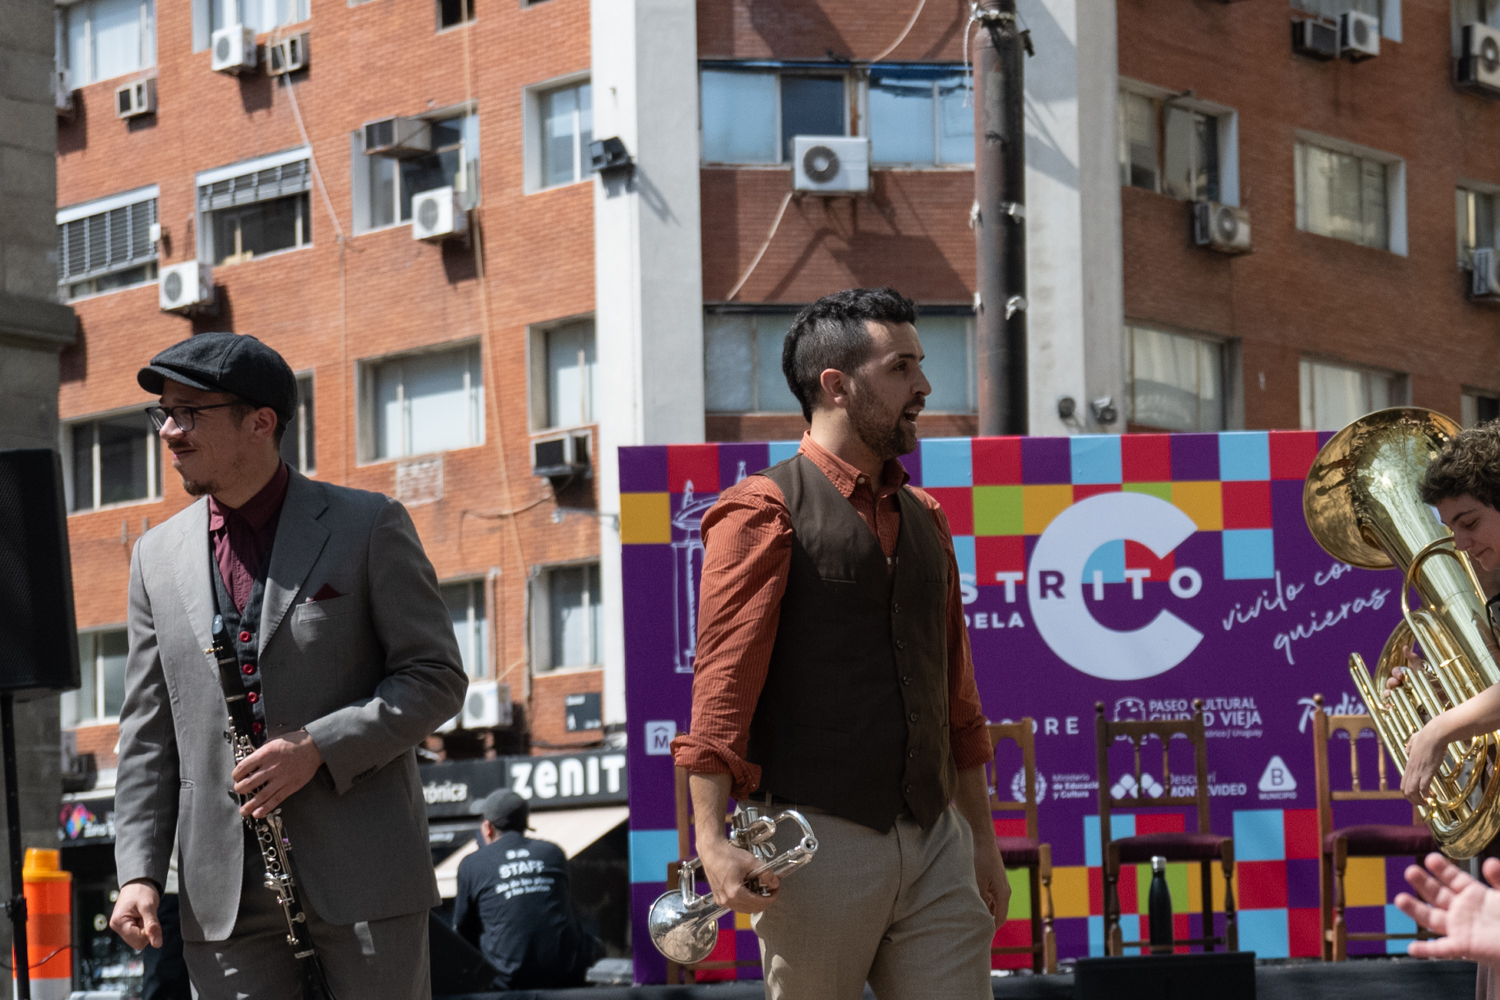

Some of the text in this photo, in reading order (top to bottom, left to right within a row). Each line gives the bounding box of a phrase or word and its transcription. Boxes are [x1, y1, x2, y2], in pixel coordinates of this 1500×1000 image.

[1273, 588, 1392, 666] quieras
[1148, 699, 1188, 712] PASEO
[1220, 710, 1262, 729] VIEJA
[1052, 773, 1090, 782] Ministerio
[1271, 768, 1284, 786] B
[1052, 782, 1063, 790] de
[1060, 790, 1089, 799] Cultura
[499, 860, 545, 879] STAFF
